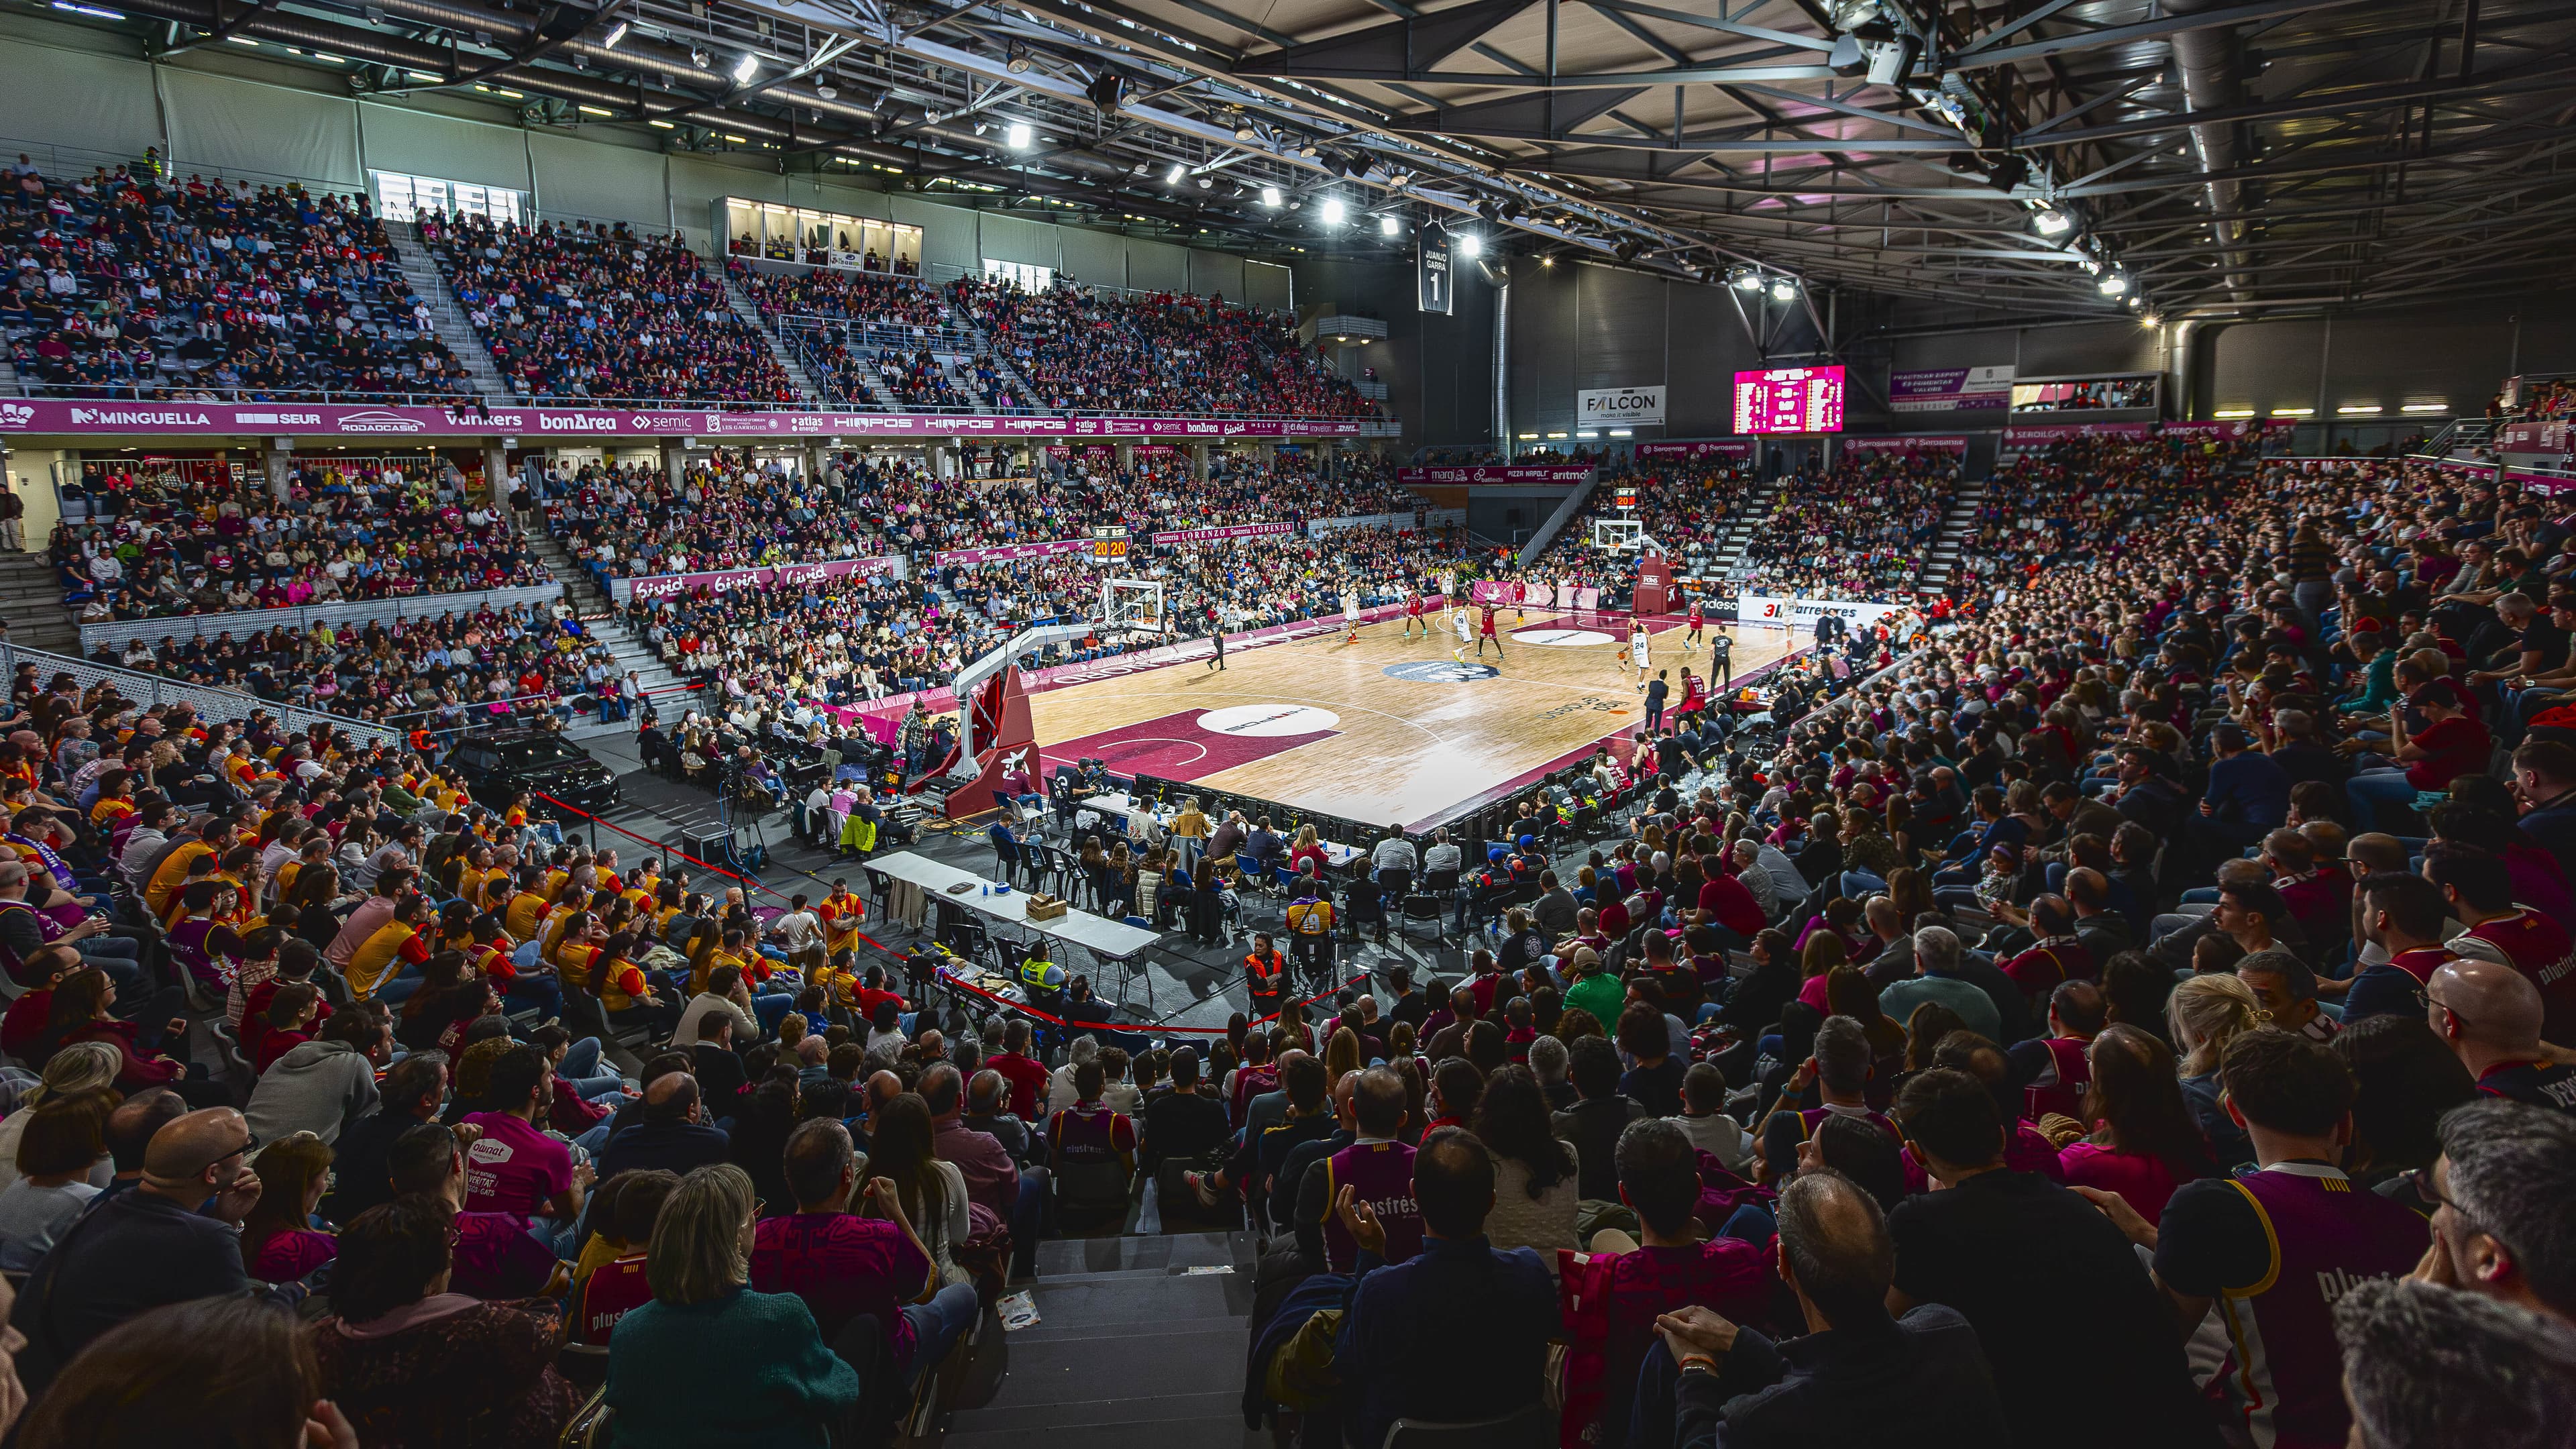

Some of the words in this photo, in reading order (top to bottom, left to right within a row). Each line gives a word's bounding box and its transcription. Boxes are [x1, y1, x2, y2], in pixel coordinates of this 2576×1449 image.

[1426, 250, 1447, 262] JUANJO
[1427, 260, 1446, 271] GARRA
[1430, 272, 1438, 301] 1
[1587, 394, 1656, 411] FALCON
[100, 412, 211, 425] MINGUELLA
[279, 413, 321, 424] SEUR
[539, 413, 617, 431] bonArea
[653, 415, 692, 427] semic
[798, 416, 823, 426] atlas
[1080, 420, 1097, 429] atlas
[1163, 421, 1181, 430] semic
[1187, 422, 1218, 433] bonArea
[1155, 533, 1179, 542] Sastreria
[1182, 529, 1226, 539] LORENZO
[1230, 527, 1251, 536] Sastreria
[1252, 524, 1291, 534] LORENZO
[1016, 546, 1037, 559] aqualia
[1094, 541, 1108, 555] 20
[1110, 541, 1126, 555] 20
[981, 549, 1003, 563] aqualia
[1701, 599, 1739, 610] ndesa
[1097, 629, 1123, 638] endesa
[1694, 684, 1704, 694] 12
[473, 1143, 505, 1157] ownat
[480, 1187, 495, 1197] GATS
